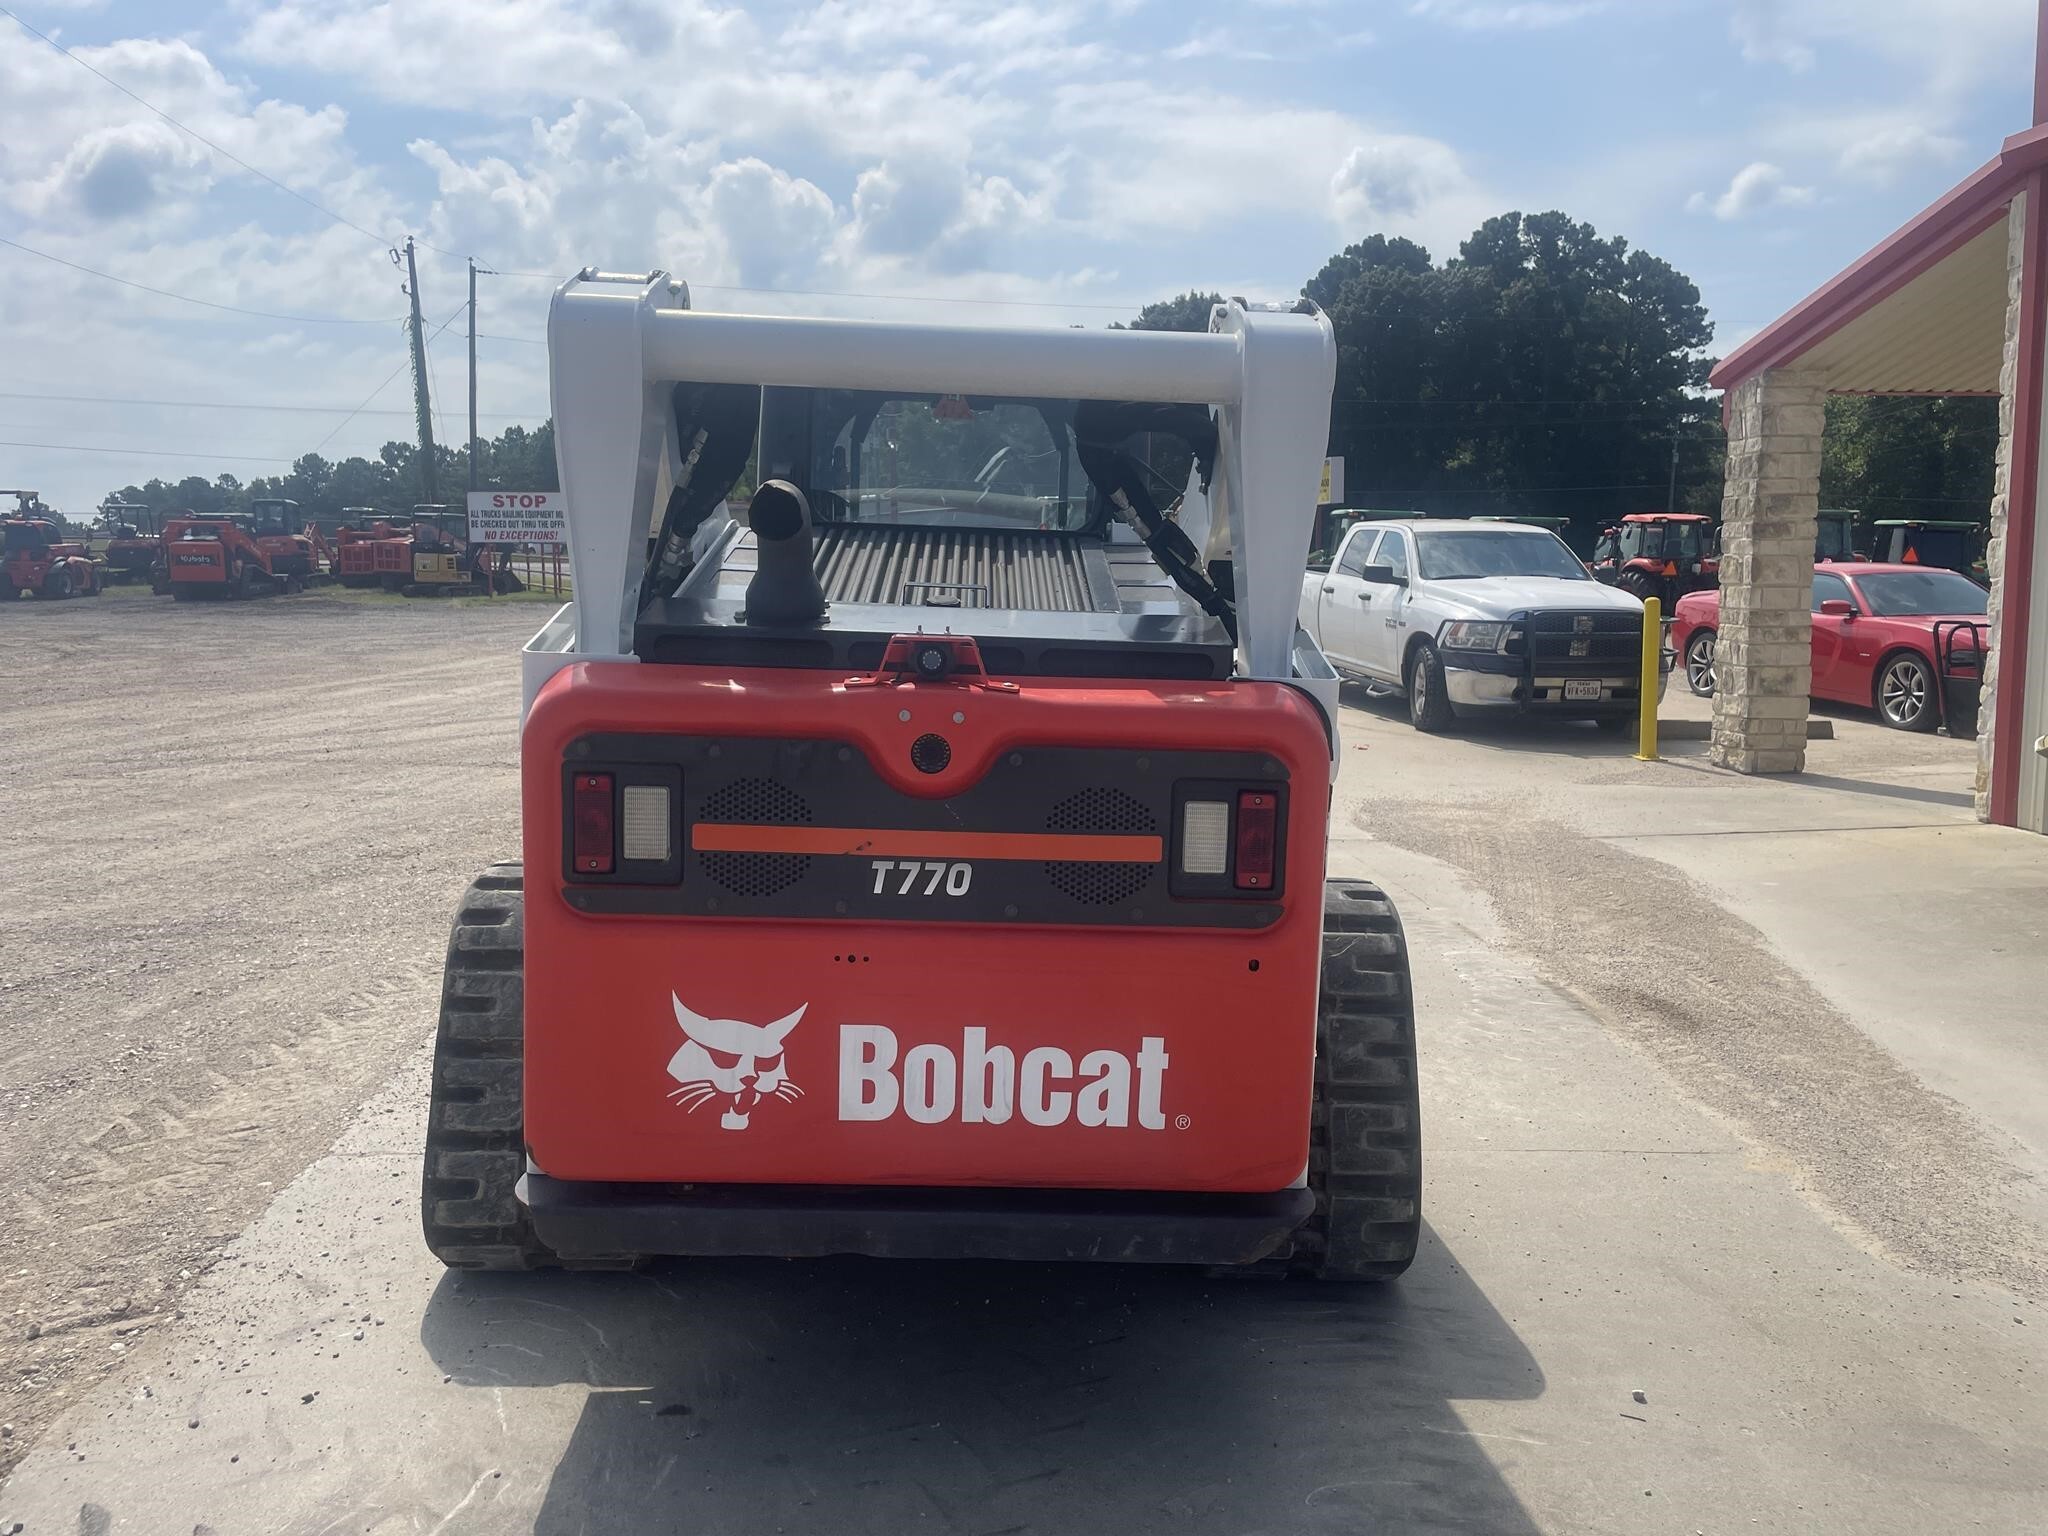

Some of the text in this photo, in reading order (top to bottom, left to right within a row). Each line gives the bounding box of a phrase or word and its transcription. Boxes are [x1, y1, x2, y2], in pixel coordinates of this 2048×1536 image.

[493, 494, 547, 508] STOP
[470, 510, 564, 519] ALL TRUCKS HAULING EQUIPMENT MU
[471, 520, 479, 529] BE
[481, 520, 507, 529] CHECKED
[508, 520, 520, 529] OUT
[521, 520, 537, 529] THRU
[539, 520, 550, 529] THE
[485, 531, 559, 540] NO EXCEPTIONS!
[871, 860, 973, 897] T770
[838, 1023, 1170, 1130] Bobcat
